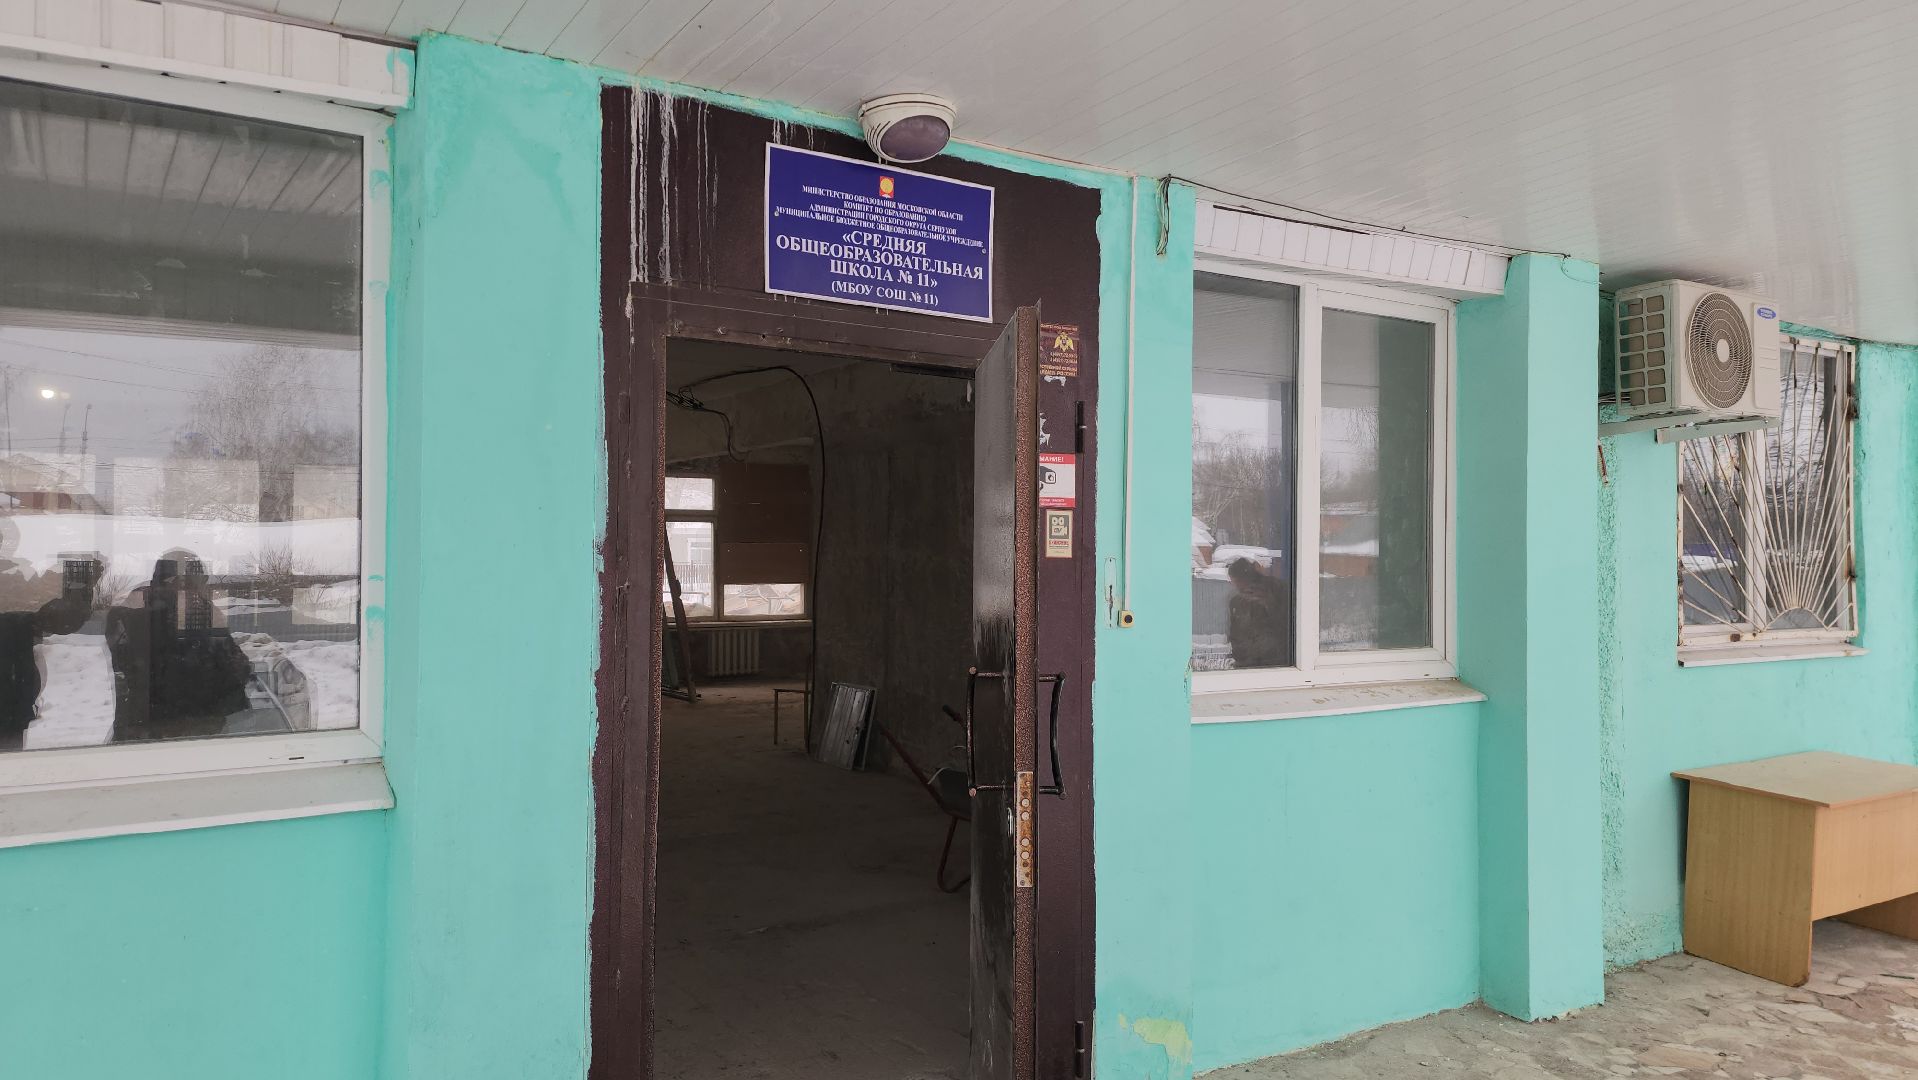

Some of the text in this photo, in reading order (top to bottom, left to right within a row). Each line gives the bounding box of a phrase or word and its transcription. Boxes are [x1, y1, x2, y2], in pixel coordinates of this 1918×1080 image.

[802, 185, 964, 221] МИНИСТЕРСТВО ОБРАЗОВАНИЯ МОСКОВСКОЙ ОБЛАСТИ
[843, 201, 927, 222] КОМИТЕТ ПО ОБРАЗОВАНИЮ
[776, 206, 984, 248] МУНИЦИПАЛЬНОЕ БЮДЖЕТНОЕ ОБЩЕОБРАЗОВАТЕЛЬНОЕ УЧРЕЖДЕНИЕ
[809, 204, 957, 235] АДМИНИСТРАЦИИ ГОРОДСКОГО ОКРУГА СЕРПУХОВ
[776, 235, 984, 280] ОБЩЕОБРАЗОВАТЕЛЬНАЯ
[842, 230, 927, 256] «СРЕДНЯЯ
[830, 260, 938, 288] ШКОЛА № 11»
[831, 281, 939, 306] (МБОУ СОШ № 11)
